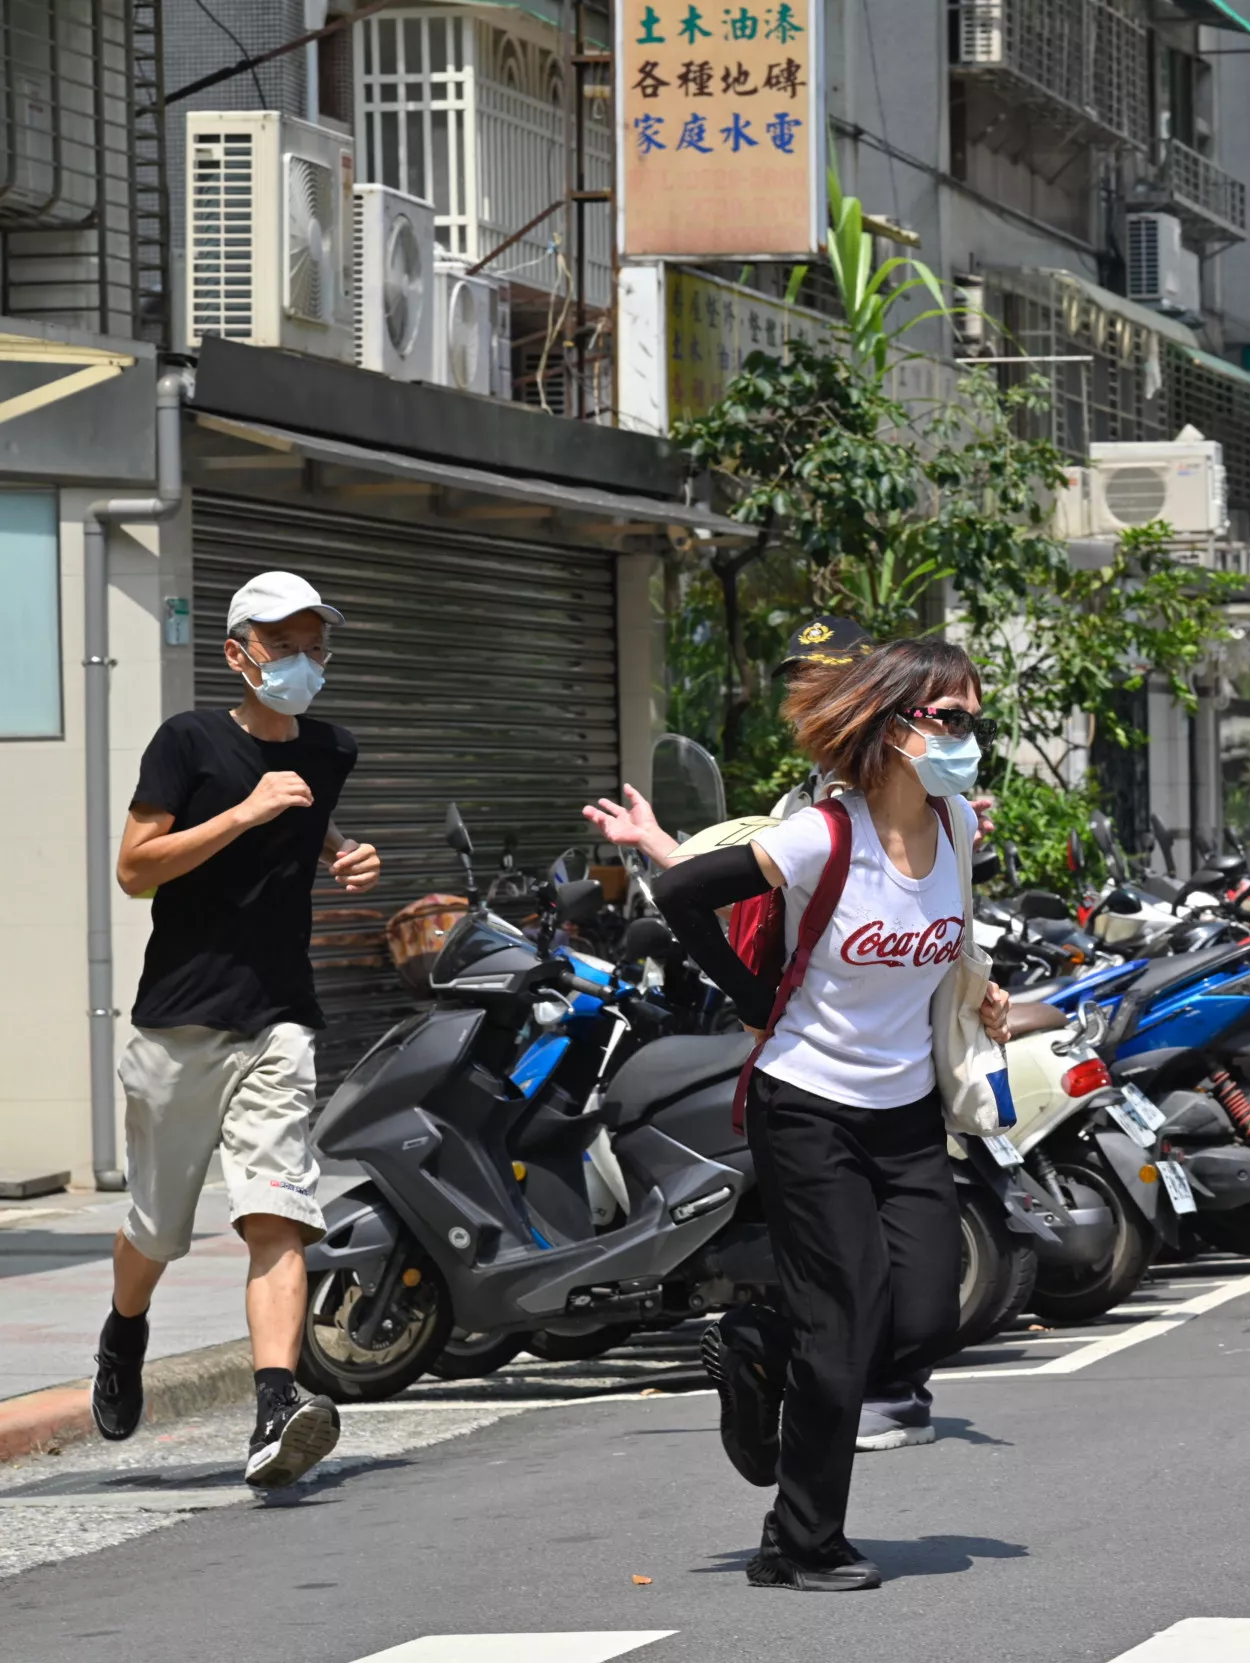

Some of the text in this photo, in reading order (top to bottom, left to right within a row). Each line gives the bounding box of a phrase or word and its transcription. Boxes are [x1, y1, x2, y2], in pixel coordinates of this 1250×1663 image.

[636, 3, 804, 44] 土木油漆
[632, 57, 807, 99] 各種地磚
[633, 112, 803, 154] 家庭水電
[840, 916, 965, 968] Coca-Col
